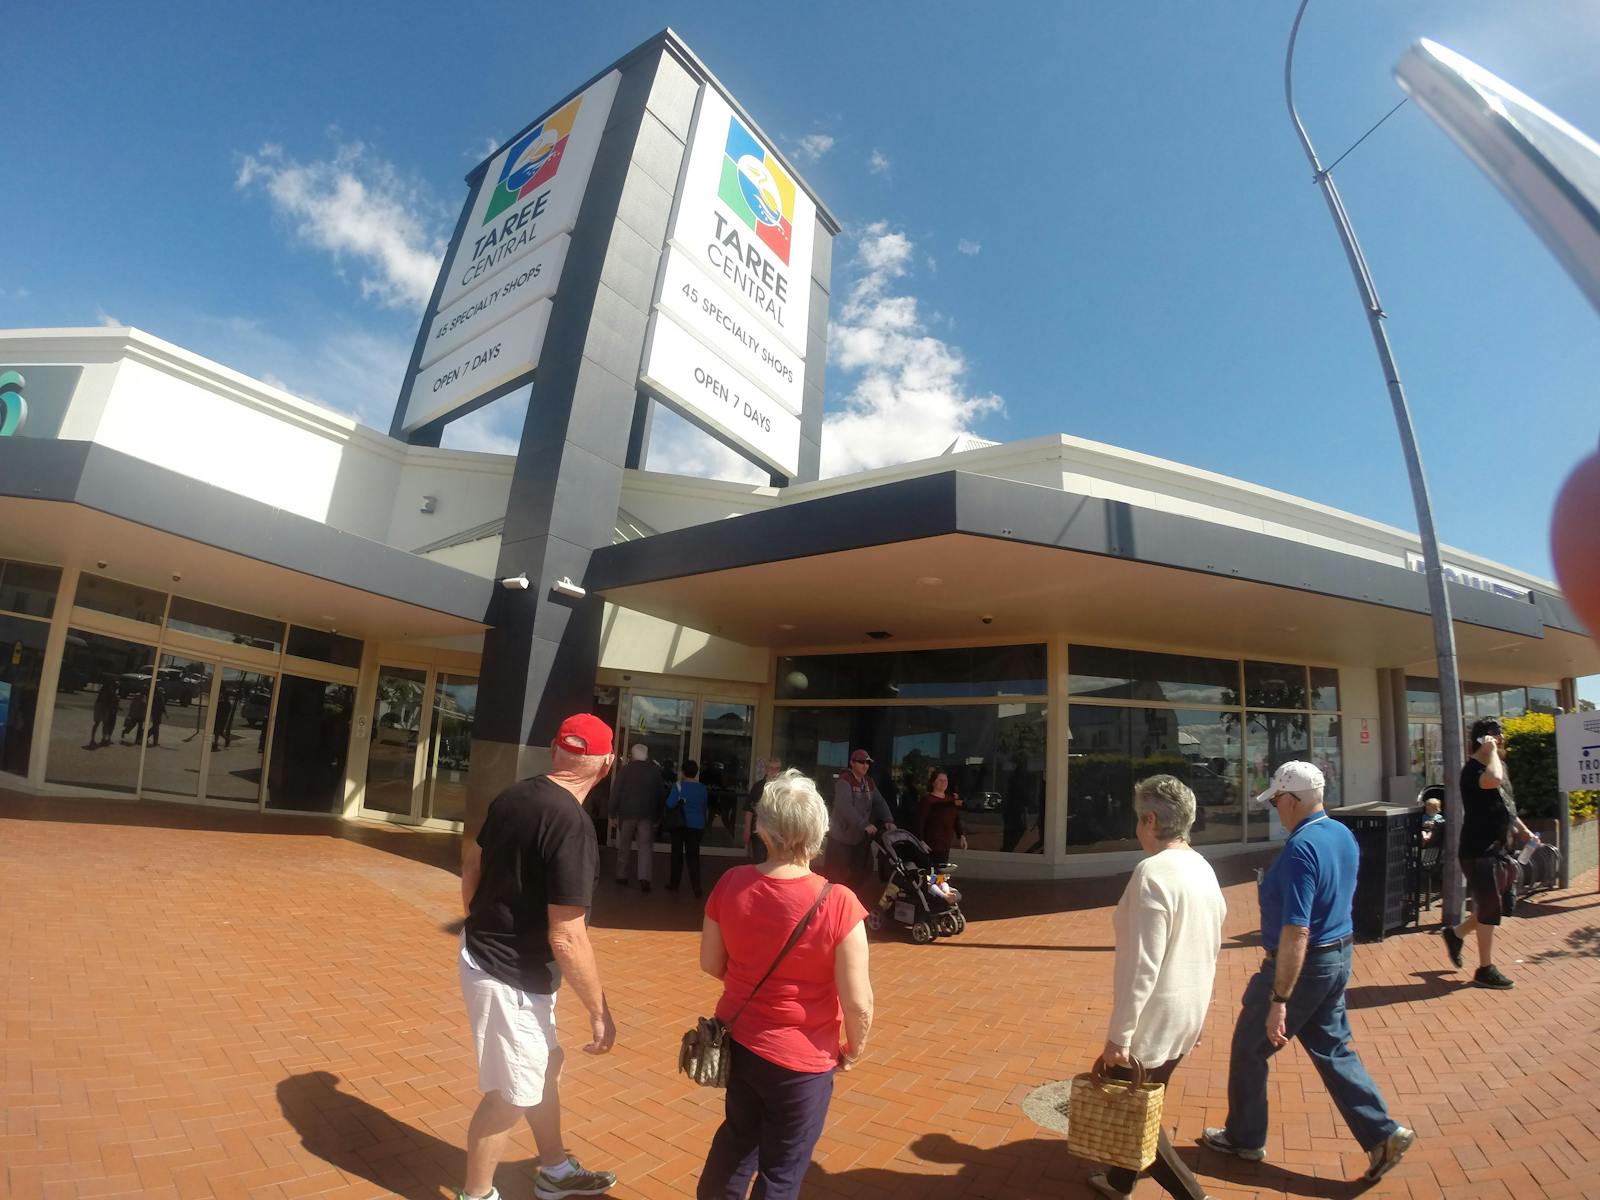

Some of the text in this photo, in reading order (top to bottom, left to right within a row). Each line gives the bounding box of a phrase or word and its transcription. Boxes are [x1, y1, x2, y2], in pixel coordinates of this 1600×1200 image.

[461, 223, 536, 286] CENTRAL
[472, 189, 551, 261] TAREE
[714, 210, 788, 304] TAREE
[436, 264, 542, 339] 45 SPECIALTY SHOPS
[707, 243, 784, 328] CENTRAL
[433, 343, 502, 393] OPEN 7 DAYS
[682, 283, 793, 384] 45 SPECIALTY SHOPS
[694, 367, 771, 433] OPEN 7 DAYS
